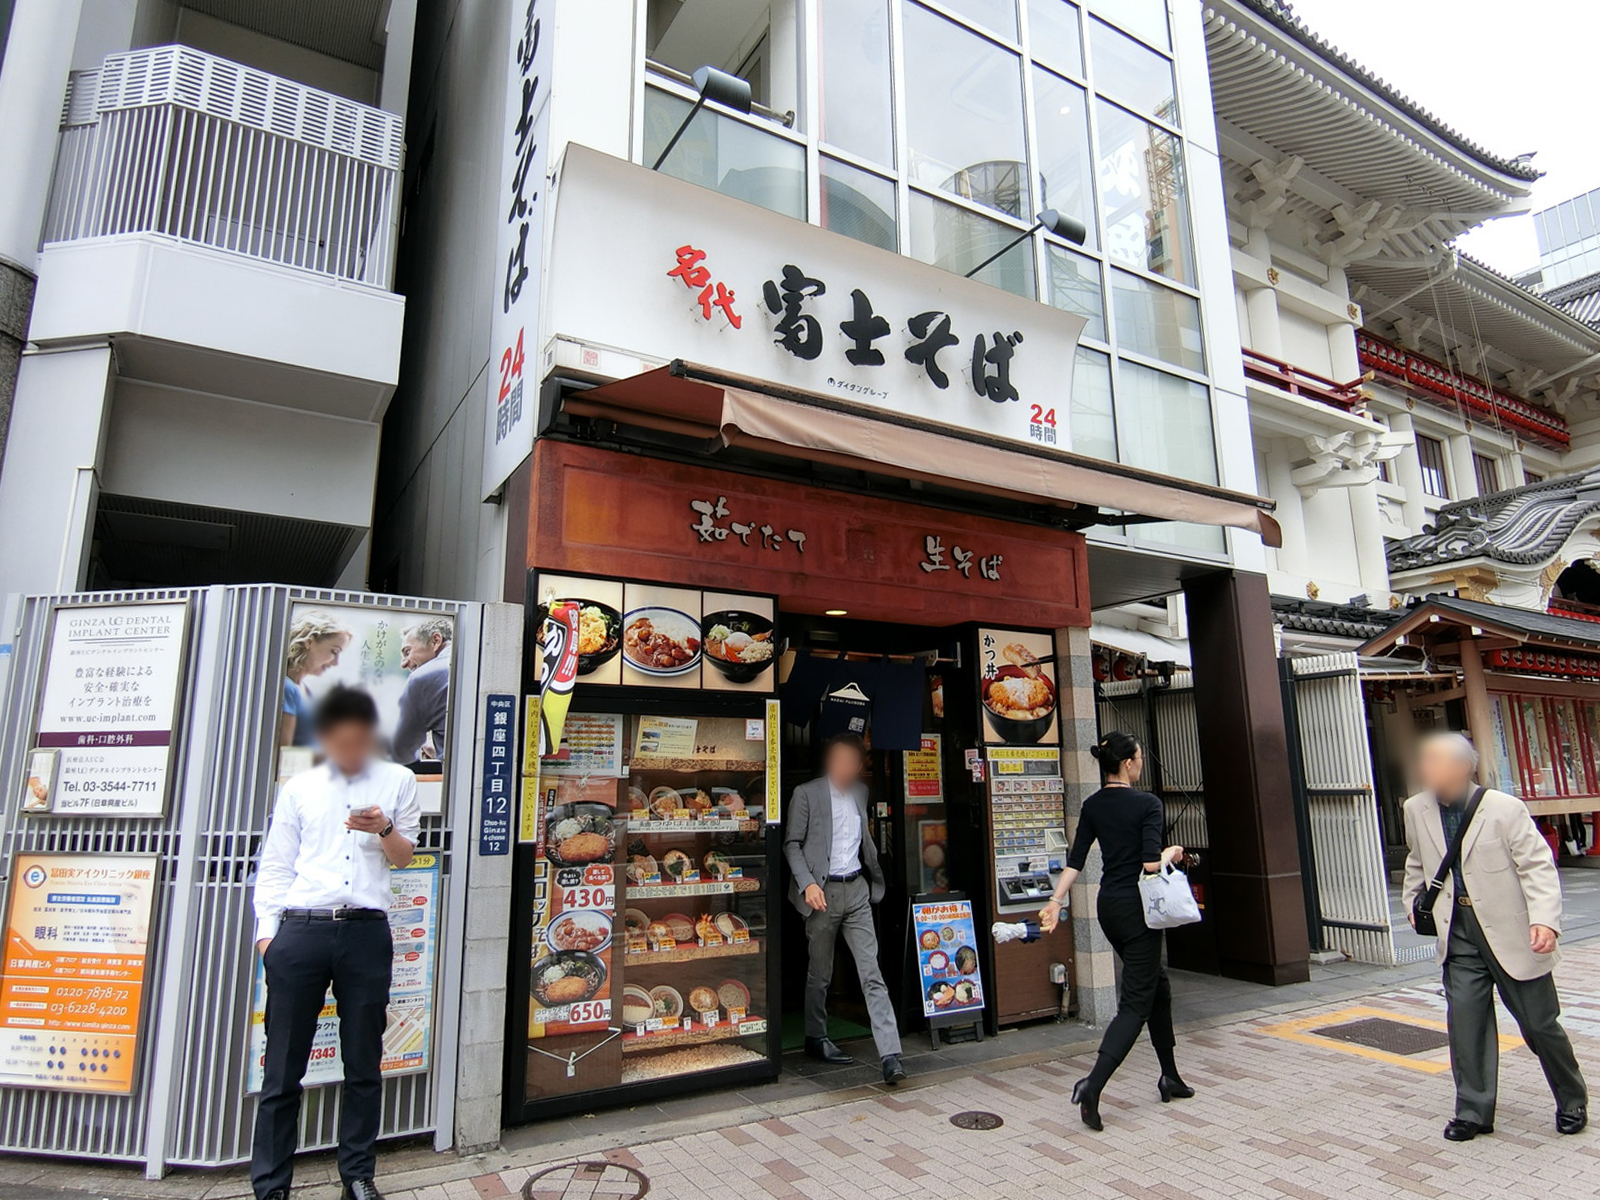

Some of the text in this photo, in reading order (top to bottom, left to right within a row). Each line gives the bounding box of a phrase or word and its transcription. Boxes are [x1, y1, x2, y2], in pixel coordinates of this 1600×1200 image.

[667, 244, 743, 330] 名代
[762, 264, 1024, 404] 富士そば
[498, 326, 525, 404] 24
[495, 378, 524, 446] 時間
[1030, 403, 1057, 428] 24
[1029, 424, 1057, 445] 時間
[690, 496, 807, 554] 茹でたて
[919, 535, 1003, 581] 生そば
[69, 618, 106, 628] GINZA
[126, 615, 172, 626] DENTAL
[68, 625, 171, 638] IMPLANT CENTER
[74, 665, 154, 679] 豊富な経験による
[68, 695, 153, 709] インプラント治療を
[491, 700, 512, 708] 中央区
[490, 711, 509, 793] 銀座四丁目
[83, 780, 157, 792] 03-3544-7711
[486, 797, 507, 814] 12
[488, 842, 500, 851] 12
[563, 888, 614, 908] 430円
[34, 926, 59, 941] 眼科
[56, 986, 129, 1001] 0120-7878-72
[50, 1001, 128, 1016] 03-6228-4200
[570, 1001, 612, 1022] 650円
